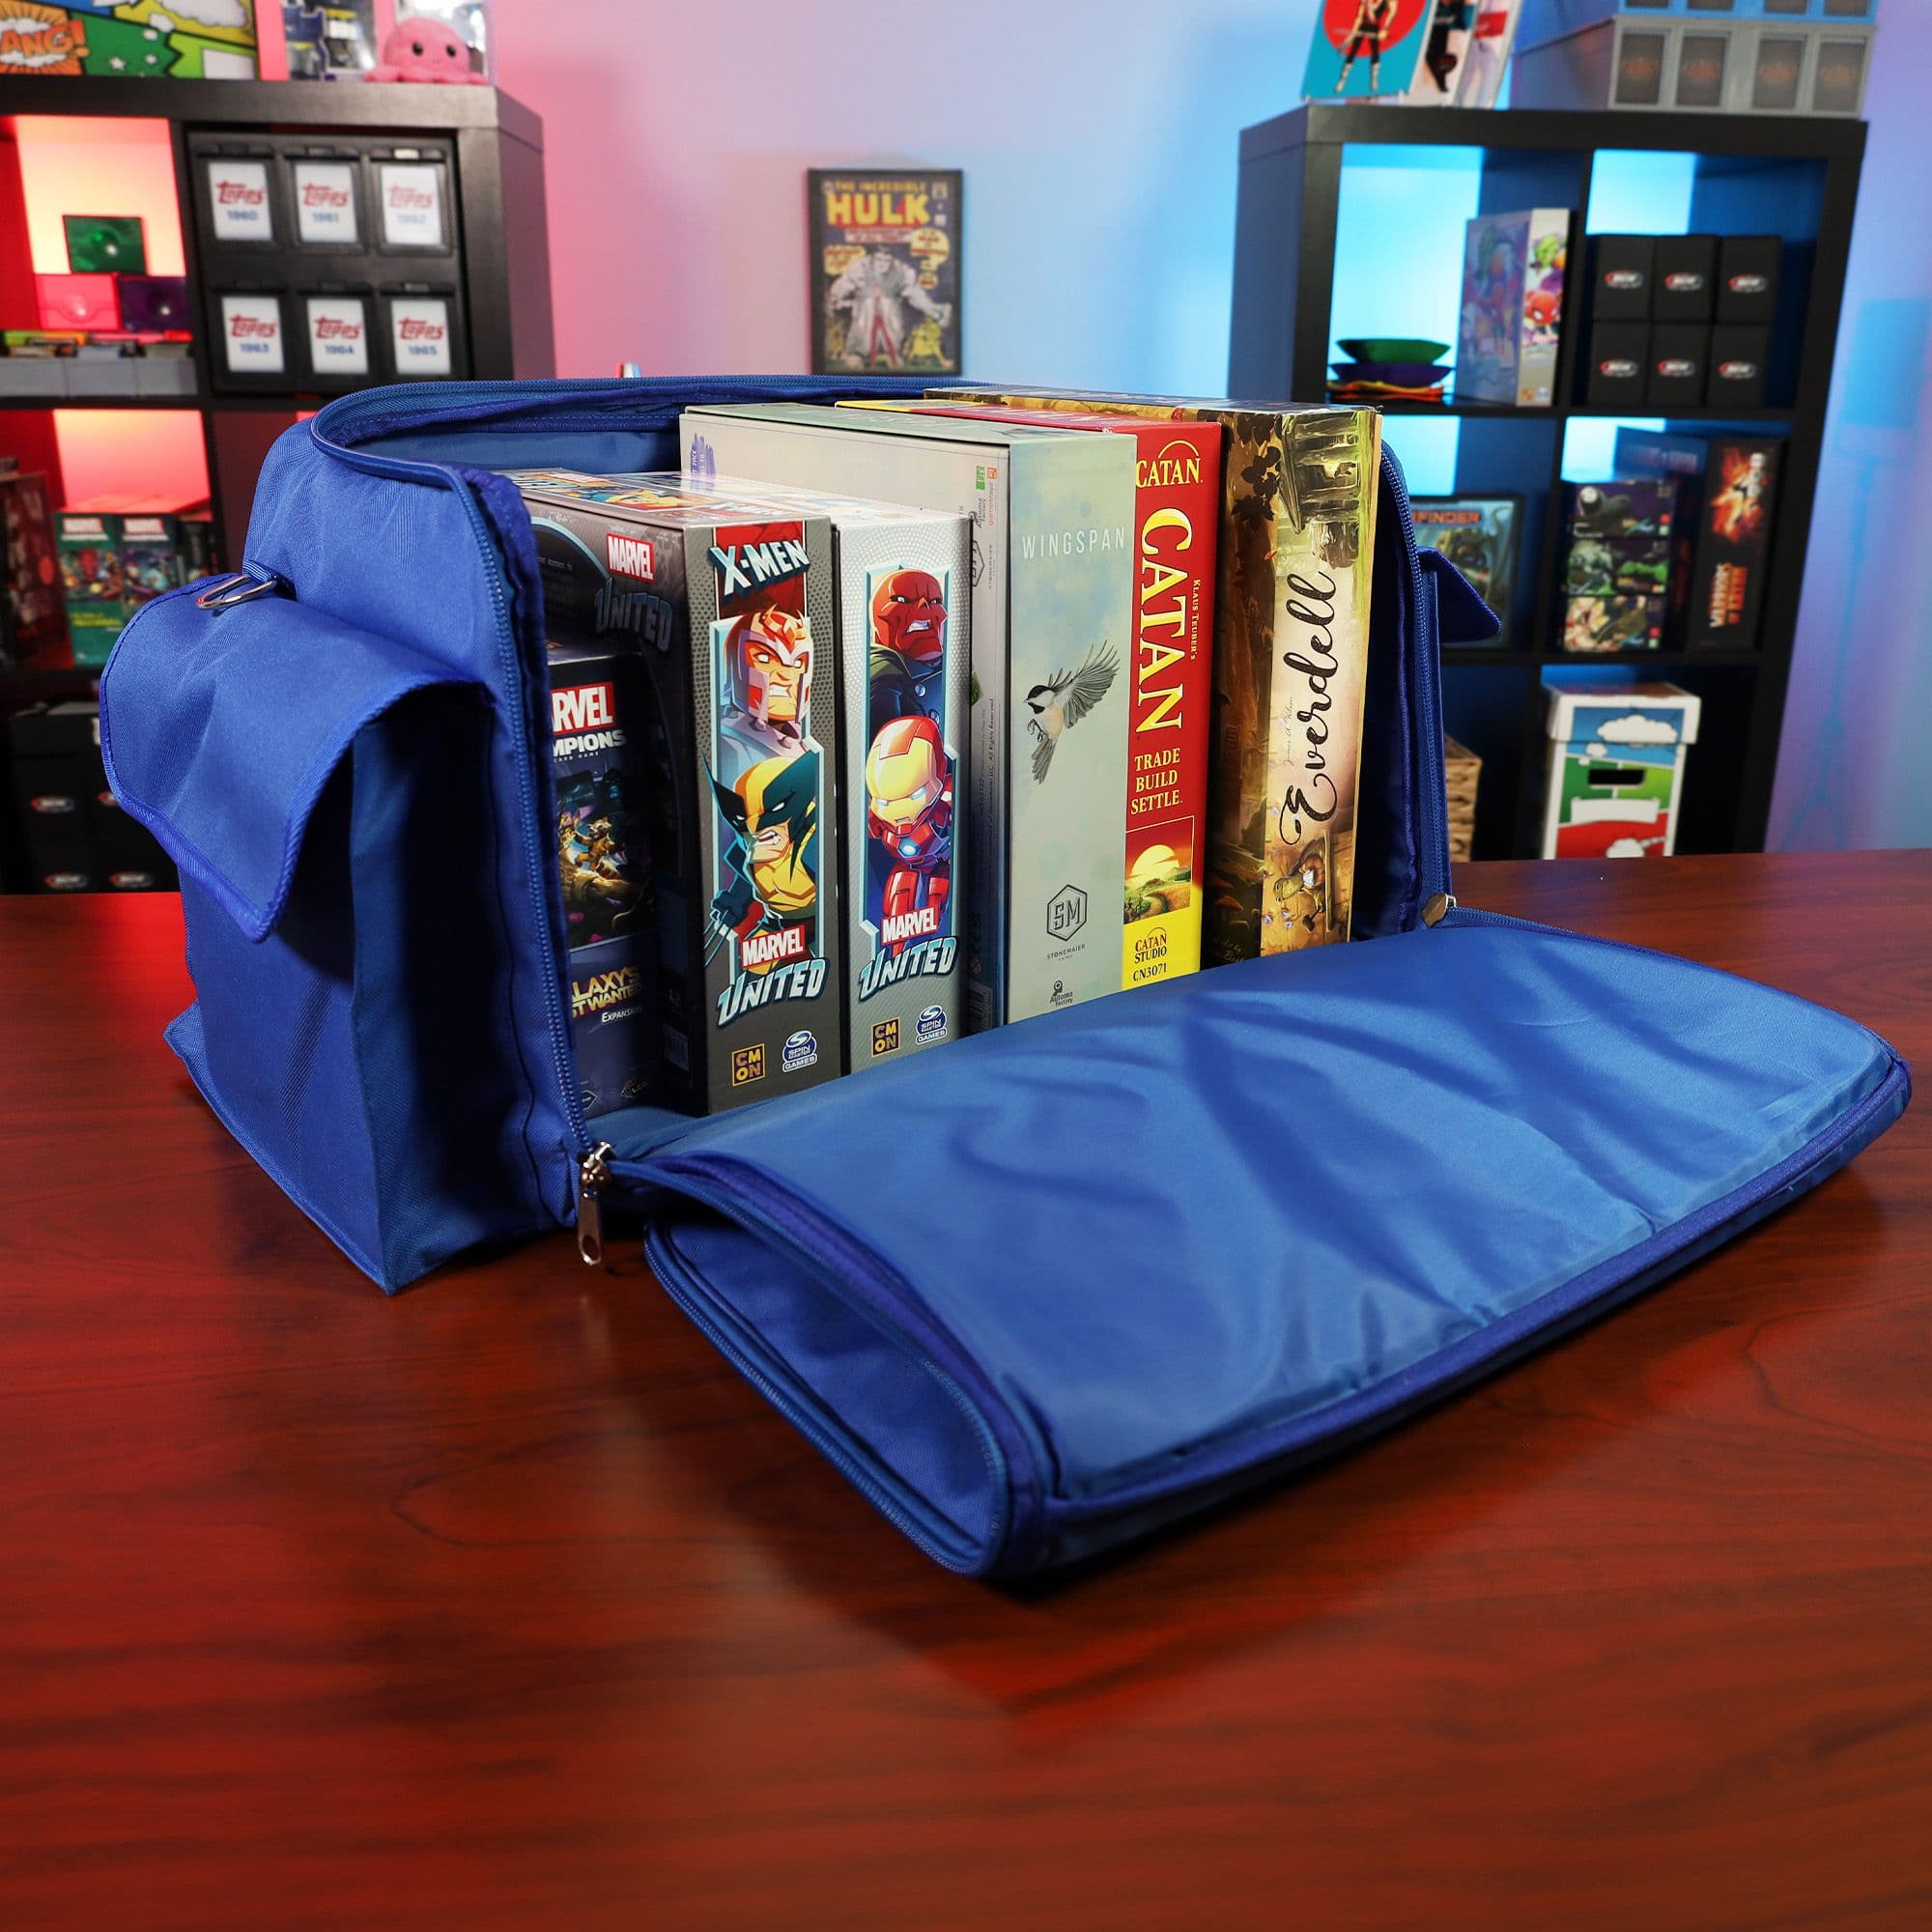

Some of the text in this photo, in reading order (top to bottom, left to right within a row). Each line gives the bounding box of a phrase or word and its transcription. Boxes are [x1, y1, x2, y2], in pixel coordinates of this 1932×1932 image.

[826, 192, 931, 225] HULK
[1022, 526, 1124, 559] WINGSPAN
[607, 535, 655, 581] MARVEL
[708, 539, 810, 597] X-MEN
[1192, 580, 1201, 611] KLAUS
[594, 577, 673, 652] UNITED
[1136, 507, 1193, 732] CATAN
[552, 686, 613, 732] RVEL
[1280, 571, 1339, 845] Everdell
[1135, 748, 1180, 772] TRADE
[1136, 770, 1179, 793] BUILD
[882, 907, 939, 944] MARVEL
[742, 928, 804, 967] MARVEL
[1046, 944, 1086, 960] STONEMAIER
[1135, 932, 1167, 952] CATAN
[1134, 946, 1167, 964] STUDIO
[859, 936, 957, 1000] UNITED
[1132, 963, 1167, 981] CN3071
[572, 966, 641, 1001] LAXY'S
[717, 958, 828, 1027] UNITED
[1050, 991, 1073, 1004] Automa
[874, 1021, 896, 1037] CM
[921, 1018, 943, 1030] SPIN
[874, 1035, 896, 1052] ON
[918, 1030, 947, 1043] GAMES
[735, 1048, 761, 1066] CM
[787, 1043, 811, 1056] SPIN
[735, 1065, 761, 1082] ON
[784, 1055, 816, 1071] GAMES
